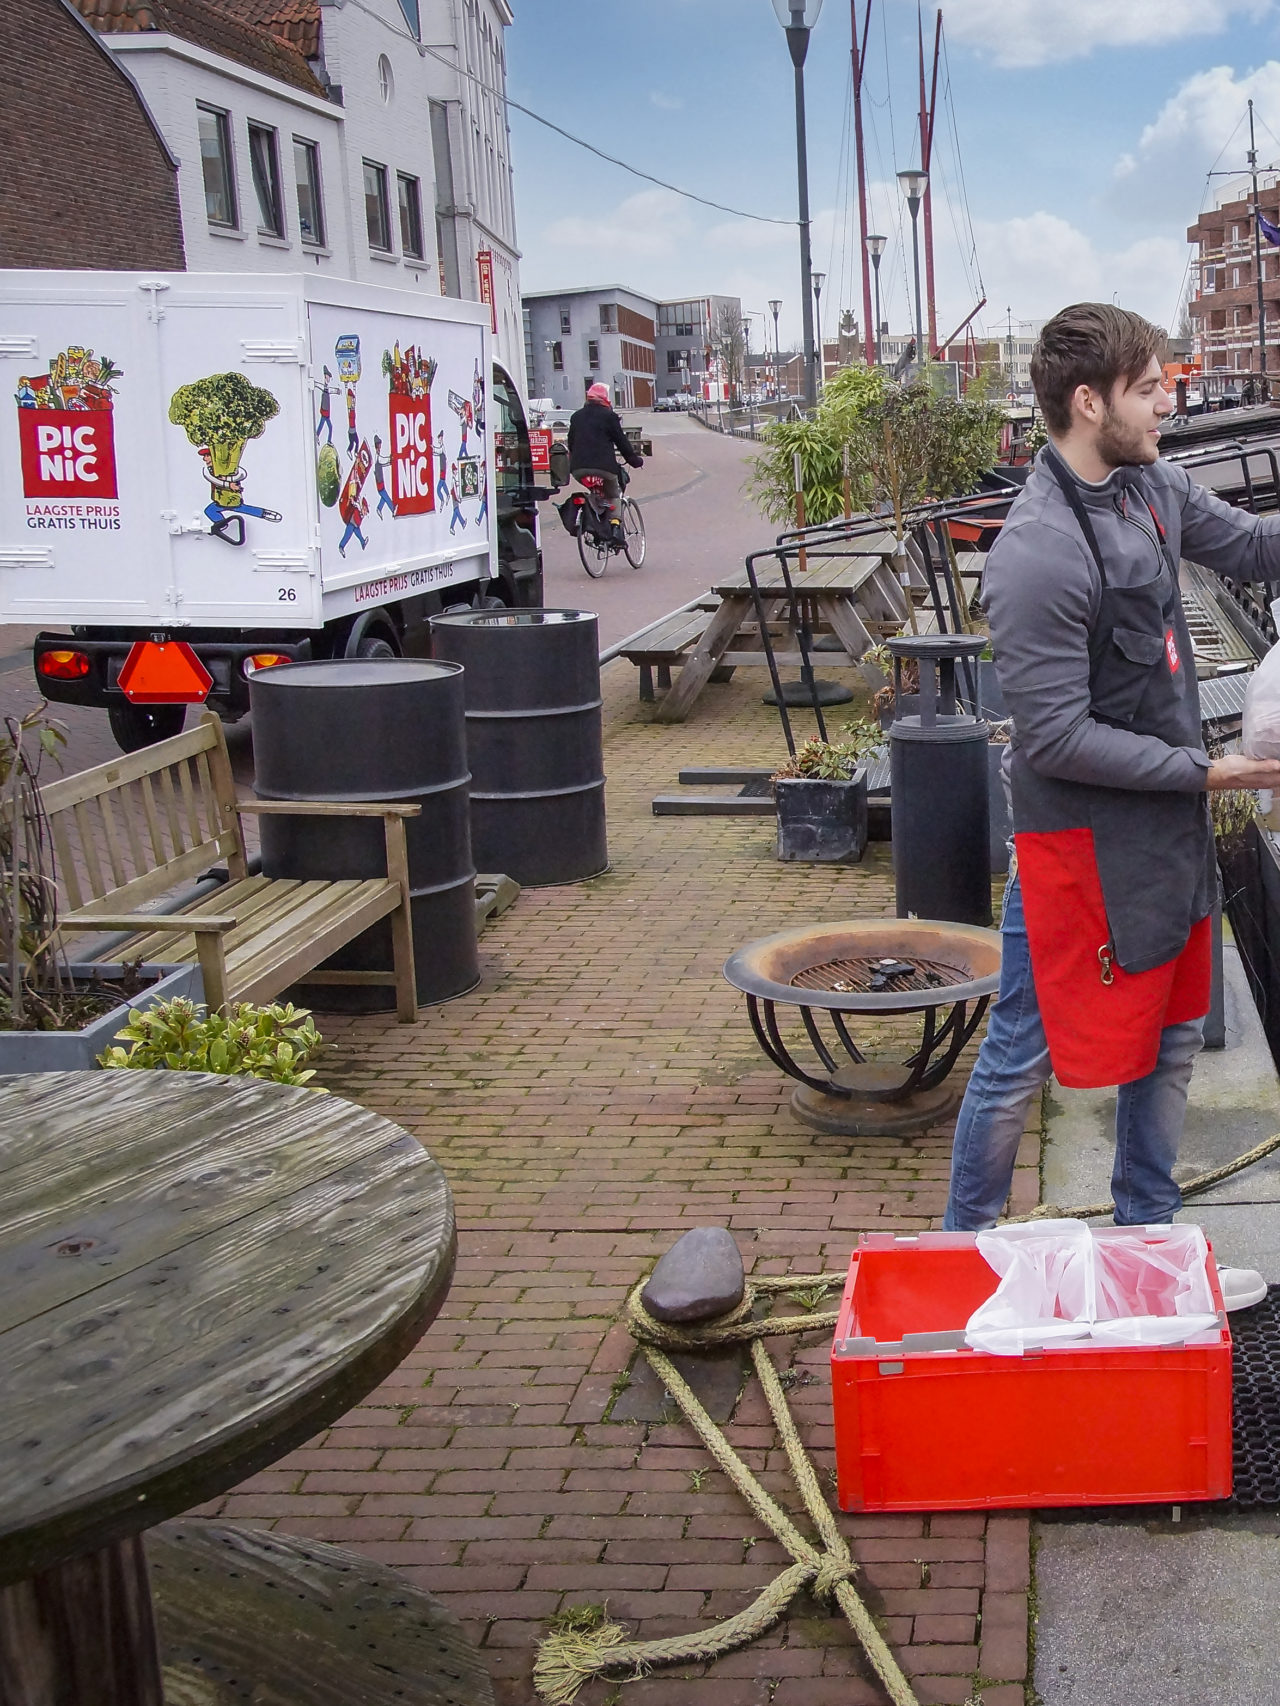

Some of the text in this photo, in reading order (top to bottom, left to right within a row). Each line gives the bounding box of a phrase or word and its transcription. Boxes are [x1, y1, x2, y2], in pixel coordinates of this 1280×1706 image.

[37, 425, 97, 453] PIC
[395, 412, 427, 454] PIC
[26, 504, 120, 517] LAAGSTE PRIJS
[27, 517, 121, 530] GRATIS THUIS
[354, 563, 454, 602] LAAGSTE PRIJS GRATIS THUIS
[277, 588, 297, 602] 26
